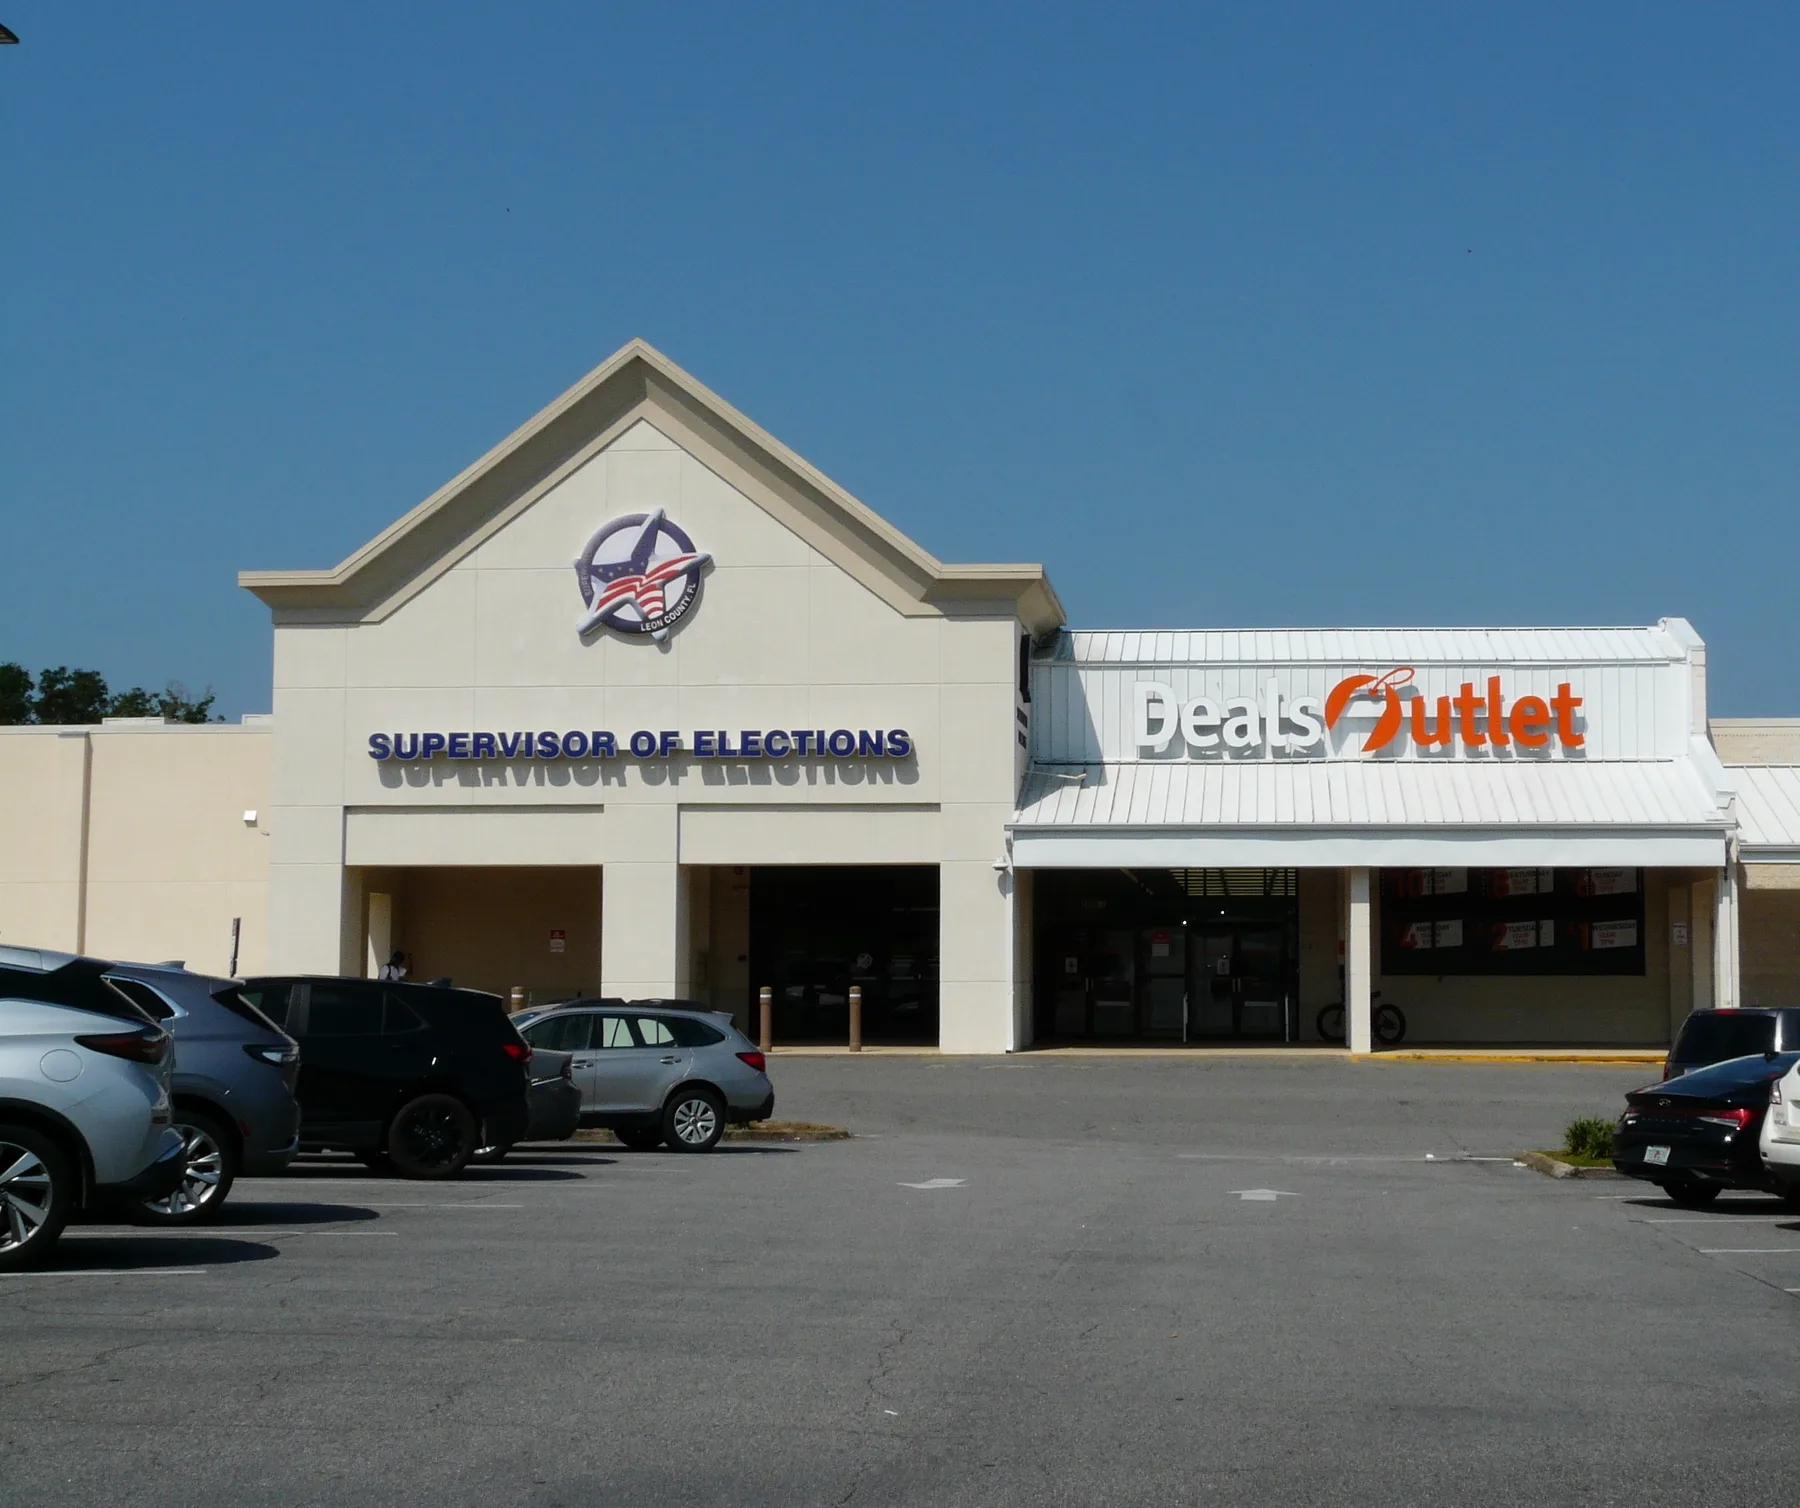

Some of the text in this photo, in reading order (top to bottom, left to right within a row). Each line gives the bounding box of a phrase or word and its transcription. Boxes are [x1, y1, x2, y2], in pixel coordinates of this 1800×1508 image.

[640, 618, 664, 631] LEON
[687, 583, 696, 594] FL
[1134, 667, 1586, 753] Deals Outlet
[368, 728, 911, 760] SUPERVISOR OF ELECTIONS
